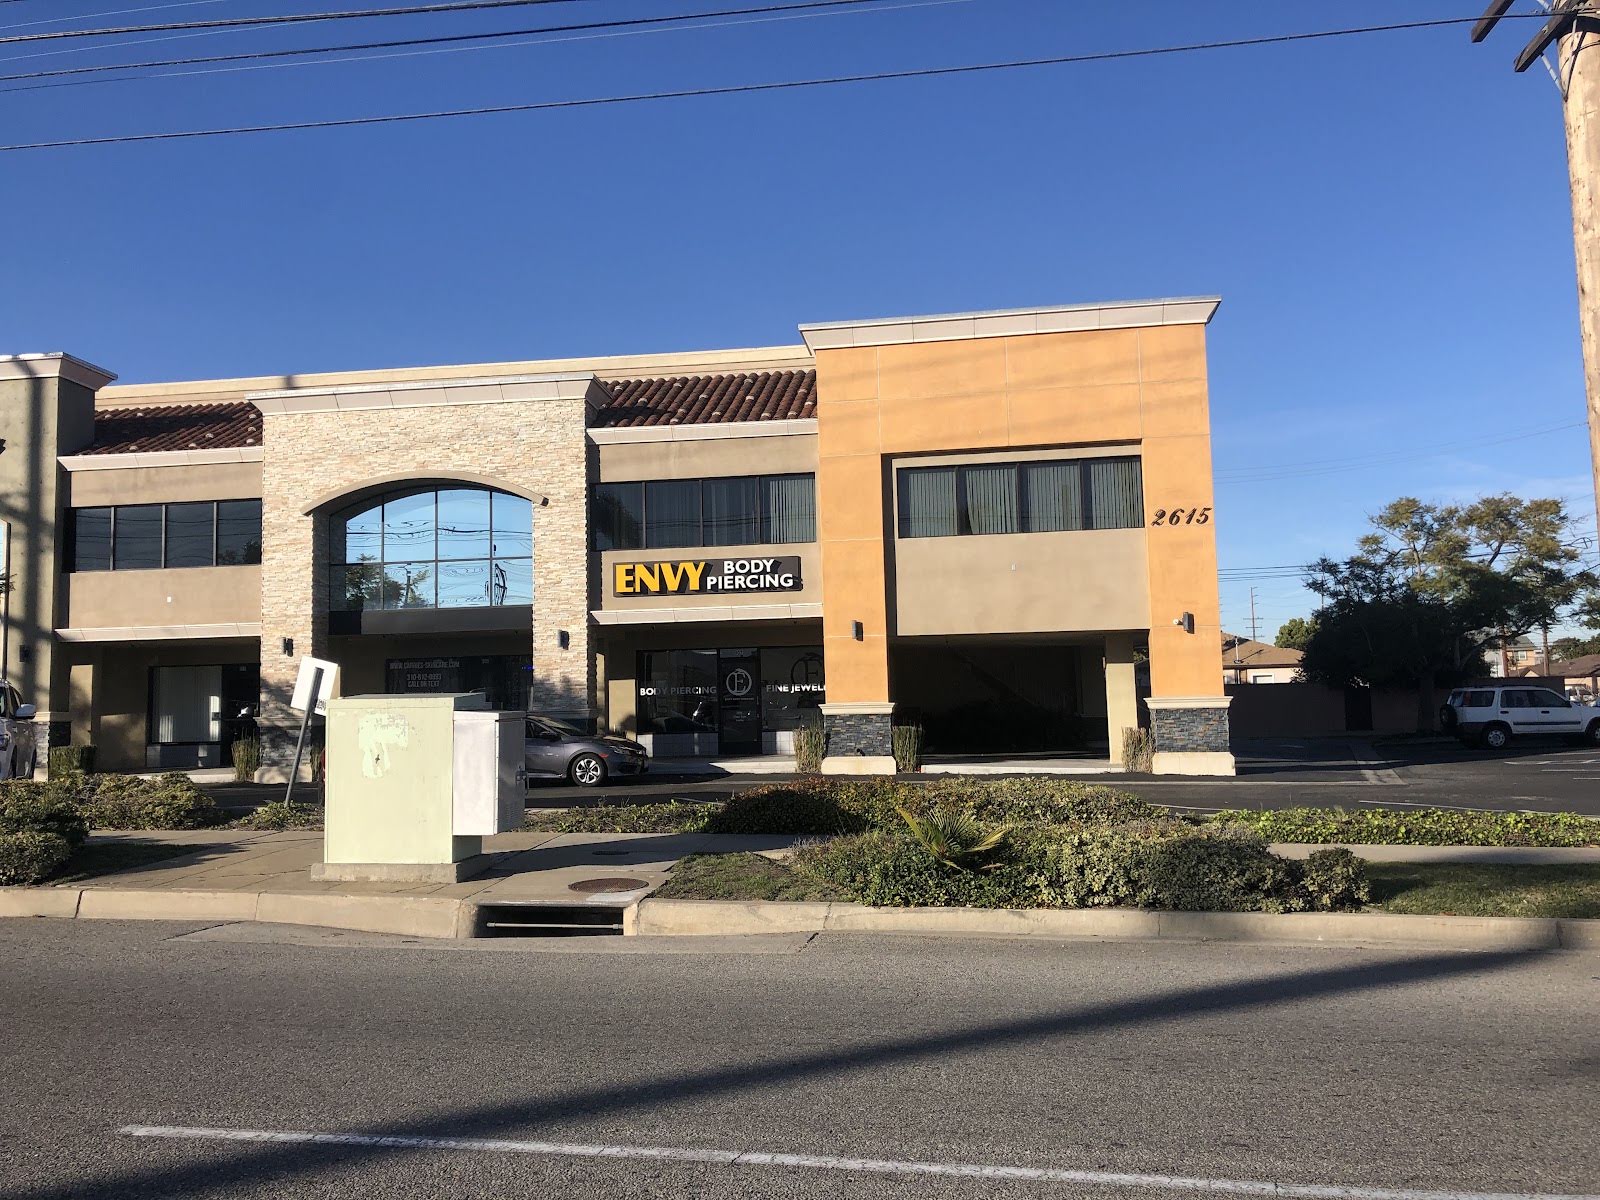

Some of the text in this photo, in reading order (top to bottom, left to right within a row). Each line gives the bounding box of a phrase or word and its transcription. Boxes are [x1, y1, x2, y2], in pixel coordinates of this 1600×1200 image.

[1151, 507, 1213, 526] 2615
[723, 558, 775, 574] BODY
[615, 561, 706, 593] ENVY
[706, 573, 793, 590] PIERCING
[639, 686, 717, 696] BODY PIERCING
[766, 683, 826, 693] FINE JEWEL
